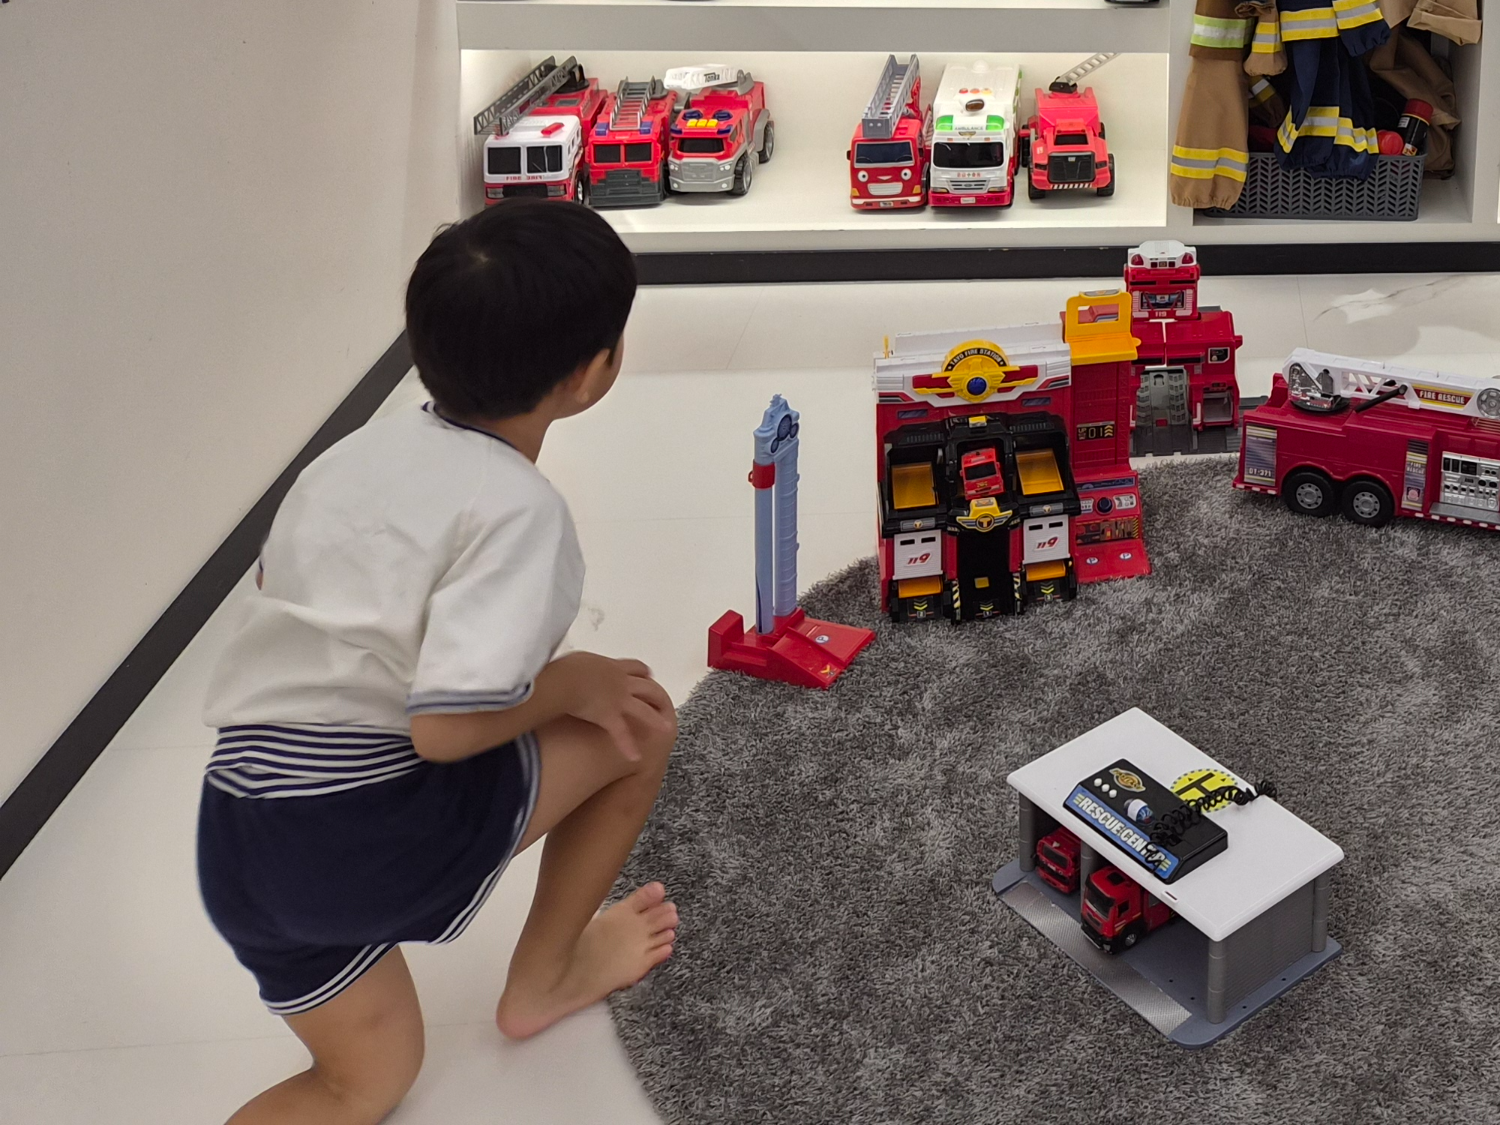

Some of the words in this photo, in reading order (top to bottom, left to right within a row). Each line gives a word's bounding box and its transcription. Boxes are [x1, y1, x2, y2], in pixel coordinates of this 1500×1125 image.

[964, 348, 979, 357] FIRE
[1419, 390, 1437, 400] FIRE
[1438, 393, 1465, 404] RESCUE
[1036, 536, 1059, 549] 119
[907, 552, 931, 565] 119
[1078, 797, 1125, 837] RESCUE
